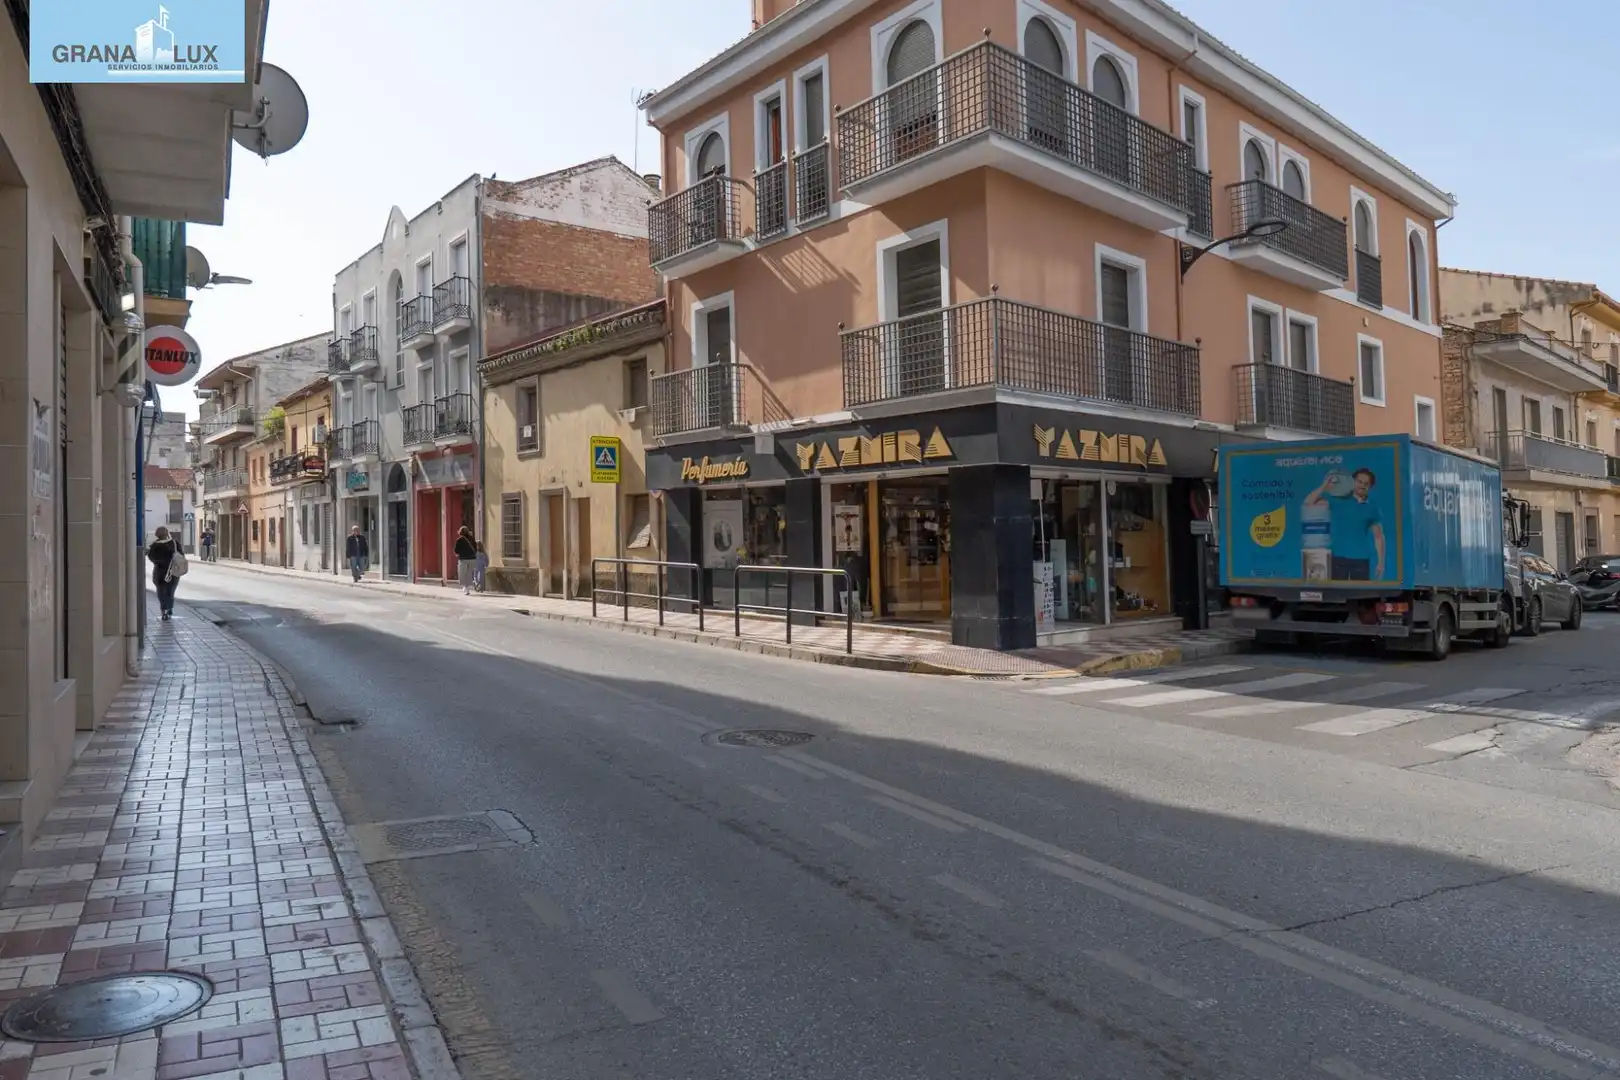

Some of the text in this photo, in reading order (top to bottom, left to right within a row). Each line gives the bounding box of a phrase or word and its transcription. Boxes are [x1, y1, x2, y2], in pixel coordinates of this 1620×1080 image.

[144, 347, 198, 365] ITANLUX
[796, 425, 953, 471] YAZMIRA
[1033, 422, 1168, 468] YAZMIRA
[1263, 514, 1272, 525] 3
